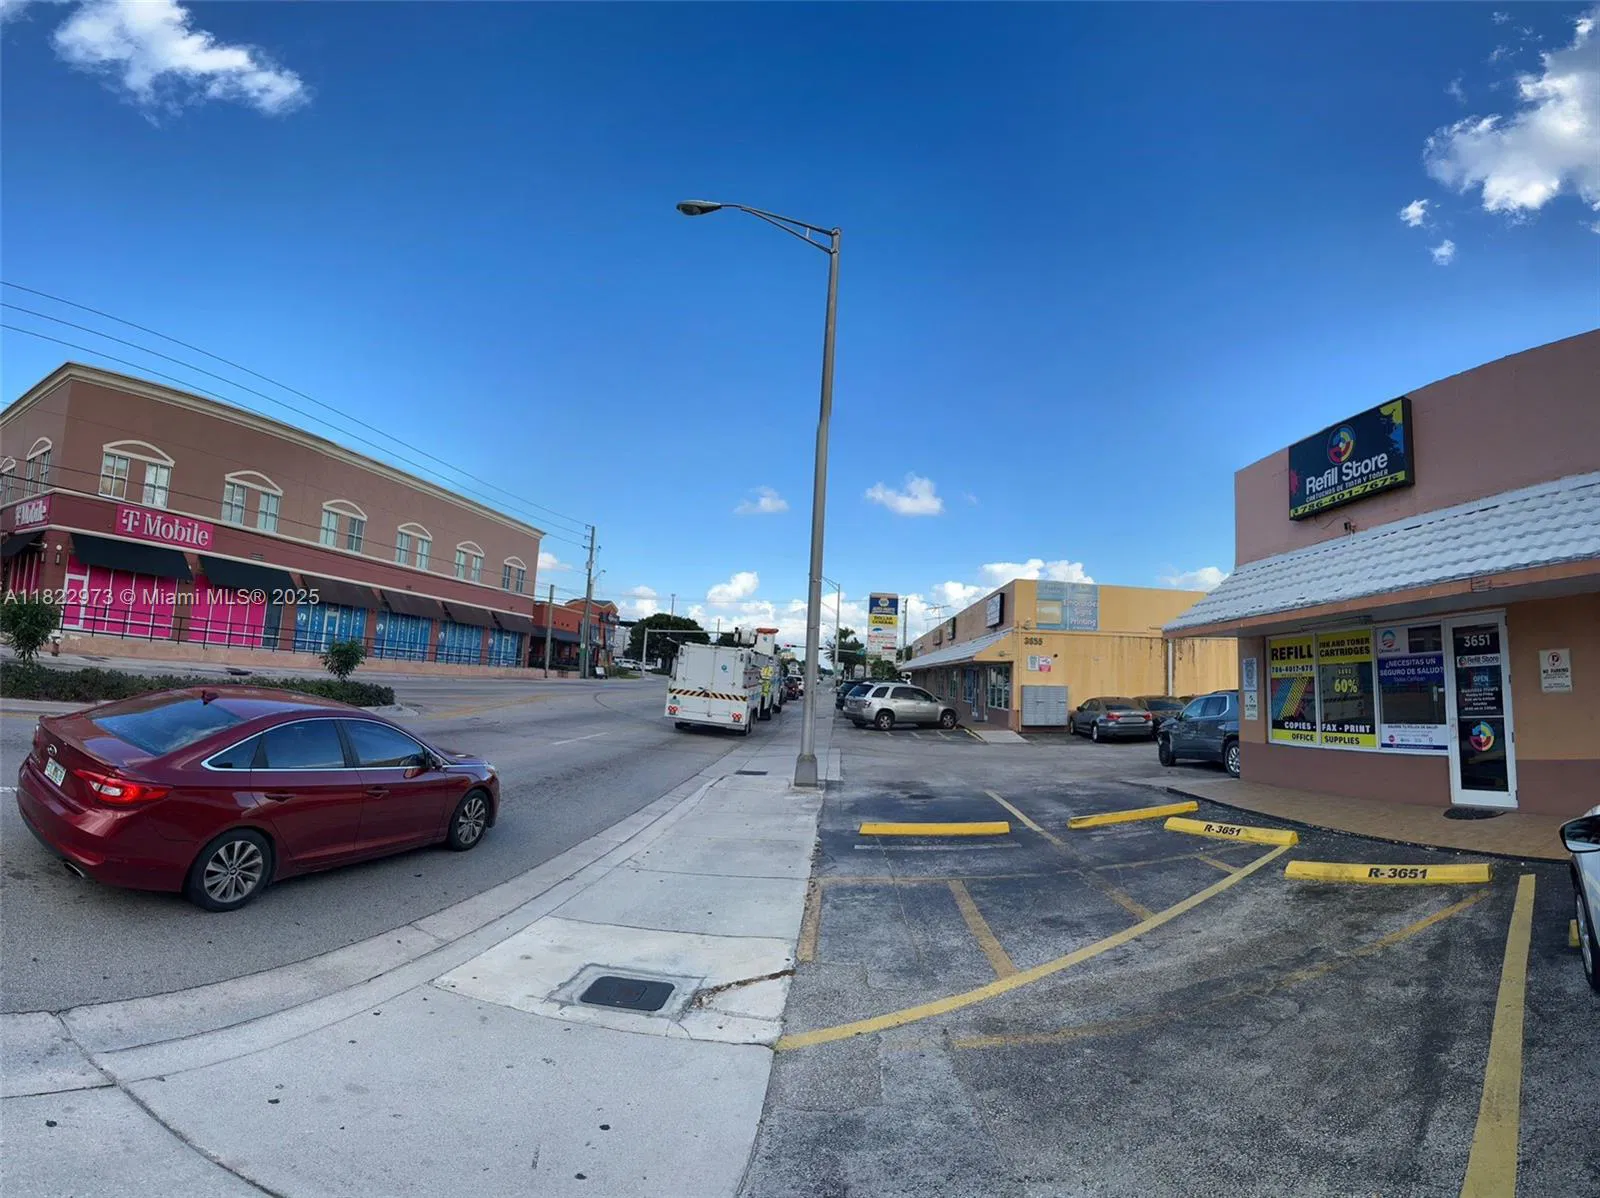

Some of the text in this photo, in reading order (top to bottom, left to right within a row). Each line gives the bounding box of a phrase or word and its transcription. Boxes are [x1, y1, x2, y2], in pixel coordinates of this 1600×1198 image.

[1306, 453, 1388, 495] Refill Store
[1336, 485, 1343, 493] DE
[1345, 478, 1362, 490] TINTA
[1368, 469, 1388, 481] TONER
[143, 513, 209, 546] Mobile
[1331, 639, 1345, 647] AND
[1347, 637, 1370, 646] TONER
[1463, 634, 1490, 647] 3651
[1271, 644, 1313, 661] REFILL
[1319, 645, 1370, 657] CARTRIDGES
[1385, 657, 1436, 668] ¿NECESITAS UN
[1481, 655, 1499, 663] Store
[1380, 668, 1406, 676] SEGURO
[1417, 666, 1444, 674] SALUD?
[1334, 678, 1358, 693] 60%
[1284, 721, 1311, 730] COPIES
[1321, 722, 1337, 732] FAX
[1344, 724, 1370, 733] PRINT
[1291, 733, 1360, 745] OFFICE SUPPLIES
